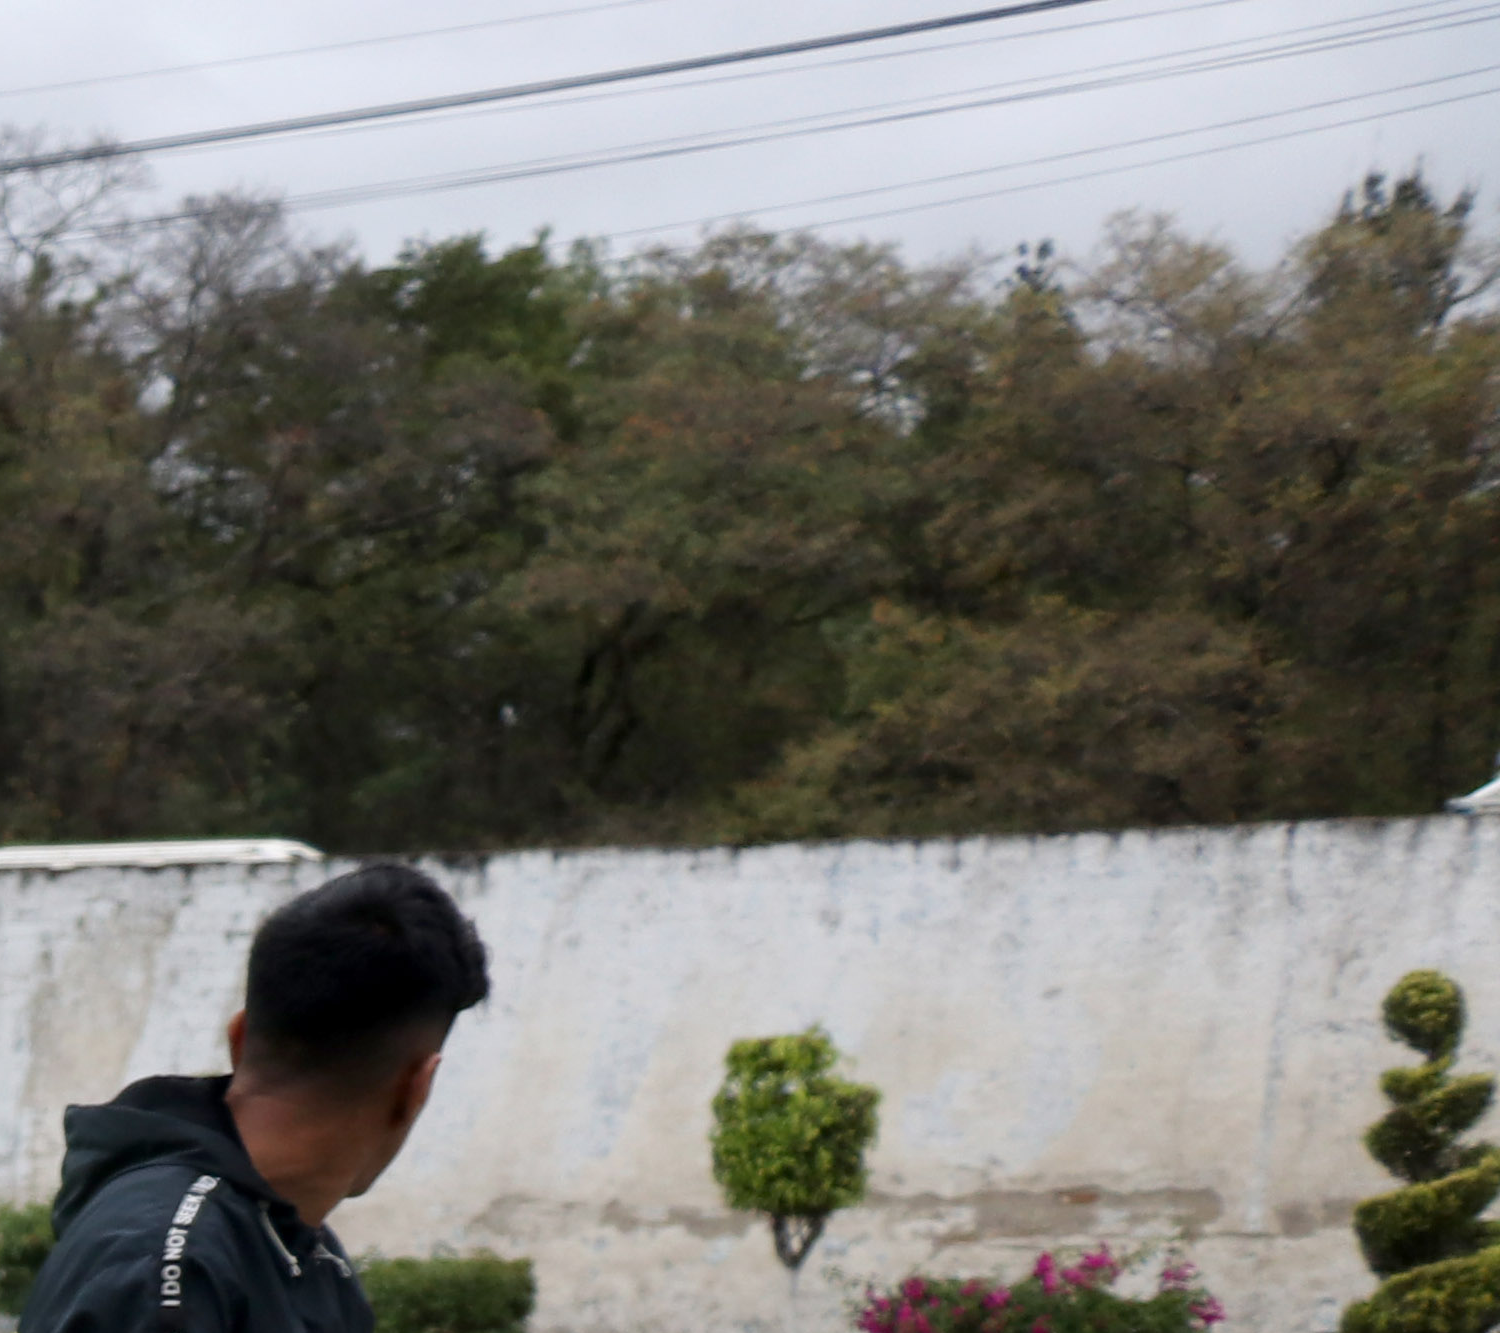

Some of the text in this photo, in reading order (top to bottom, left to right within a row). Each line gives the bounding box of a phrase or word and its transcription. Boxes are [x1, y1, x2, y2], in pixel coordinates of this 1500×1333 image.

[162, 1226, 189, 1261] NOT
[160, 1264, 182, 1296] DO
[160, 1299, 182, 1307] I
